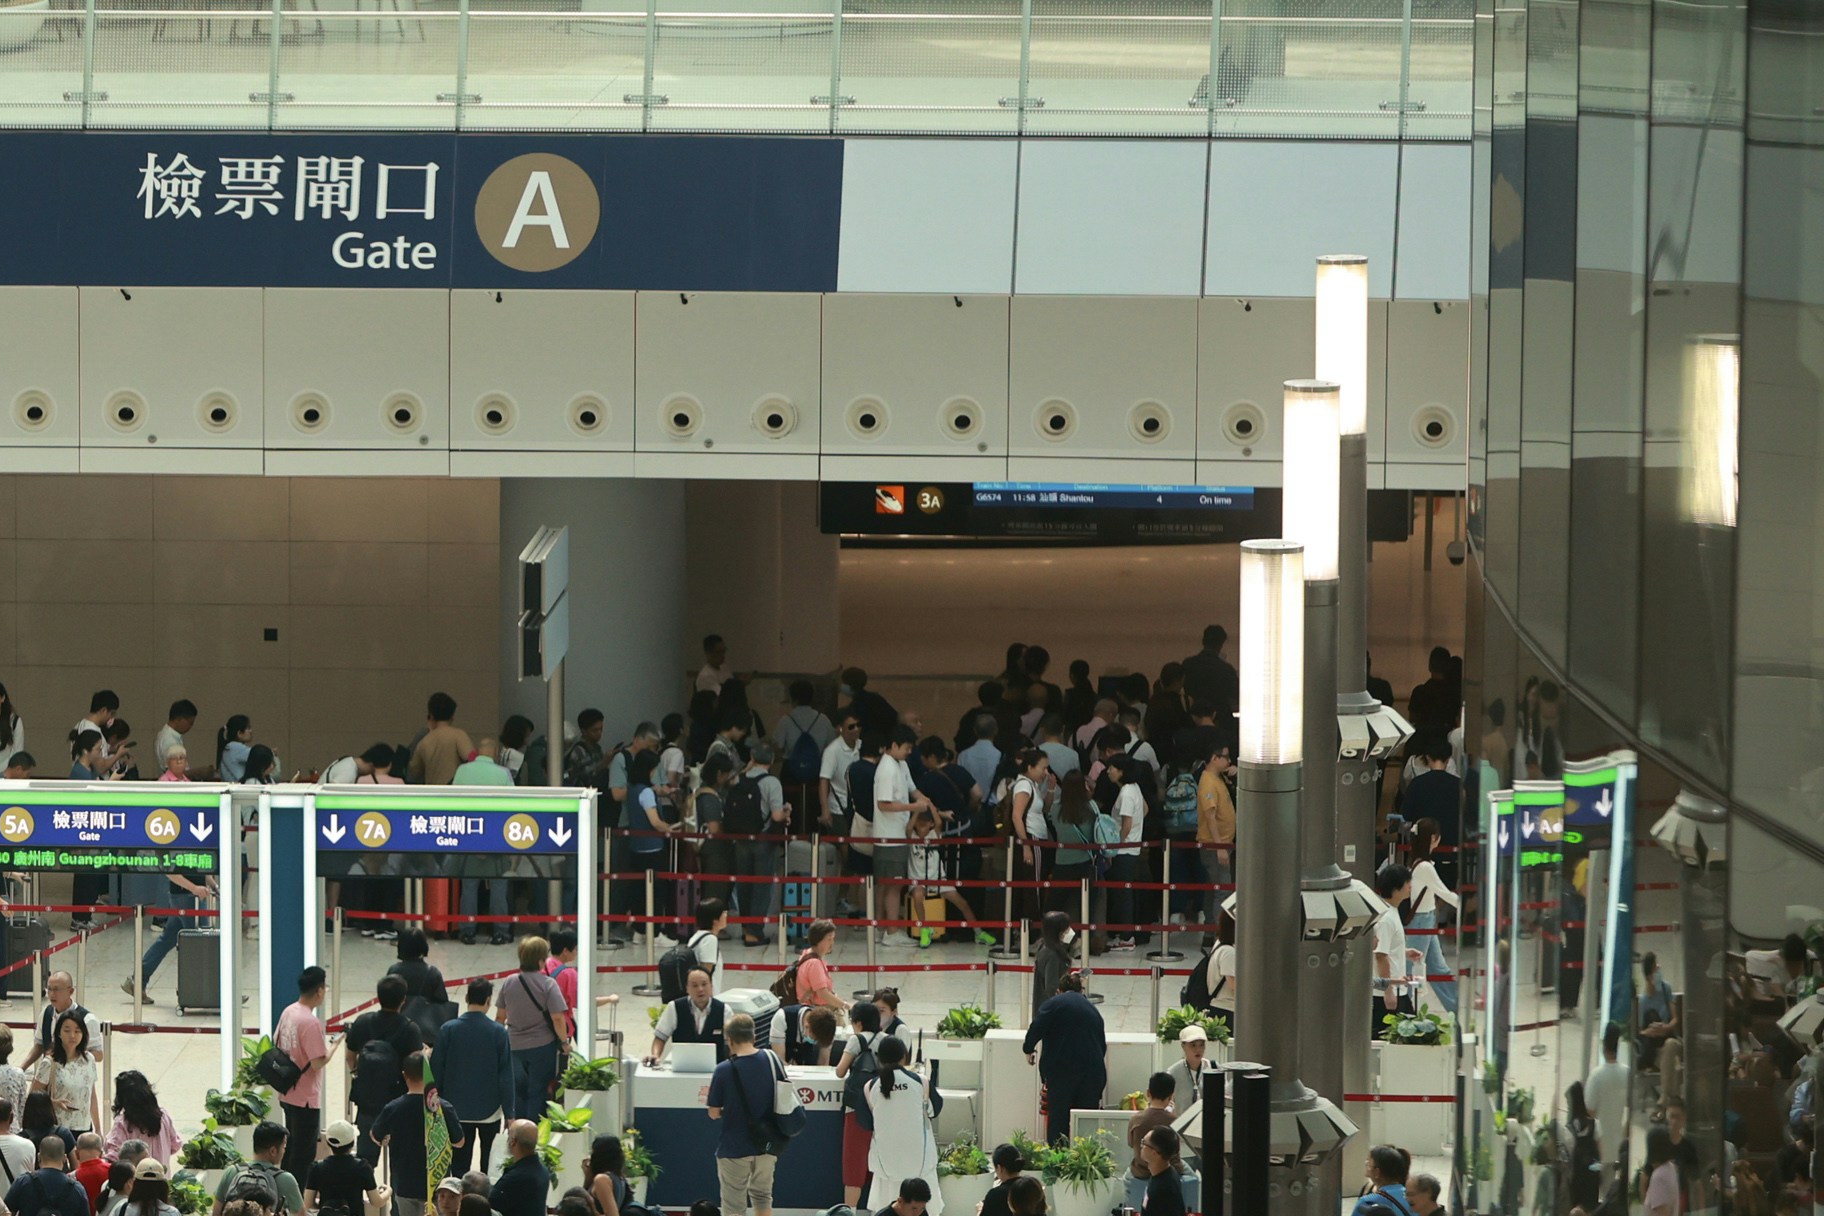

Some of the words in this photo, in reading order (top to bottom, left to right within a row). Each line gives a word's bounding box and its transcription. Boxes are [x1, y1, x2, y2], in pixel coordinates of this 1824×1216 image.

[137, 151, 440, 222] 檢票閘口
[501, 170, 570, 250] A
[331, 231, 437, 272] Gate
[921, 492, 940, 508] 3A
[976, 492, 1001, 502] G6574
[1013, 493, 1036, 502] 11:58
[1059, 492, 1094, 504] Shantou
[1156, 495, 1163, 504] 4
[1199, 495, 1213, 504] On
[1214, 495, 1232, 505] time
[5, 815, 29, 834] 5A
[53, 810, 126, 830] 檢票閘口
[149, 817, 175, 836] 6A
[409, 815, 485, 835] 檢票閘口
[78, 831, 101, 841] Gate
[362, 819, 386, 839] 7A
[508, 821, 534, 841] 8A
[436, 836, 458, 847] Gate
[59, 852, 159, 869] Guangzhounan
[817, 1090, 844, 1103] MT
